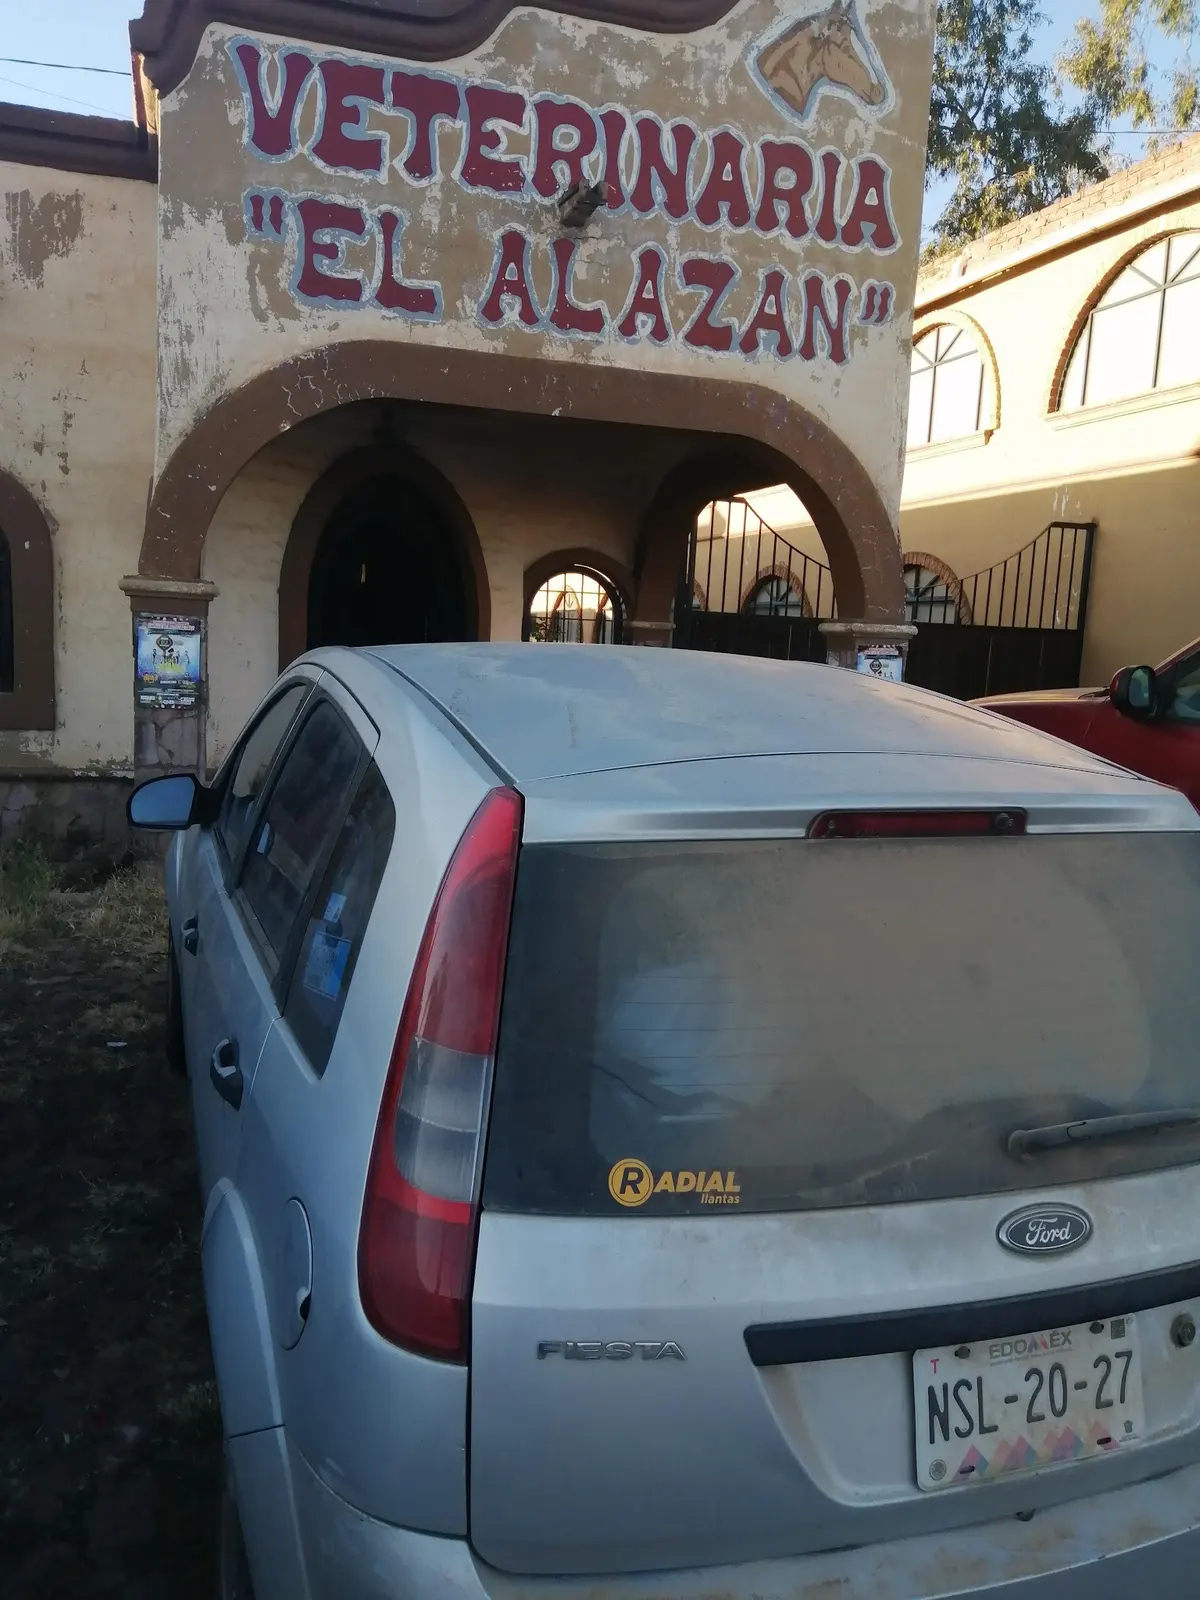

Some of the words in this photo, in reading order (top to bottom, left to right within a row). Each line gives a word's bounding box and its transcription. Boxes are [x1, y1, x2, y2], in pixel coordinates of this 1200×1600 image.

[227, 39, 899, 252] VETERINARIA
[613, 1163, 741, 1198] RADIAL
[701, 1193, 740, 1205] llantas
[1025, 1217, 1072, 1245] Ford
[536, 1340, 687, 1361] FIESTA
[927, 1350, 1133, 1445] NSL-20-27
